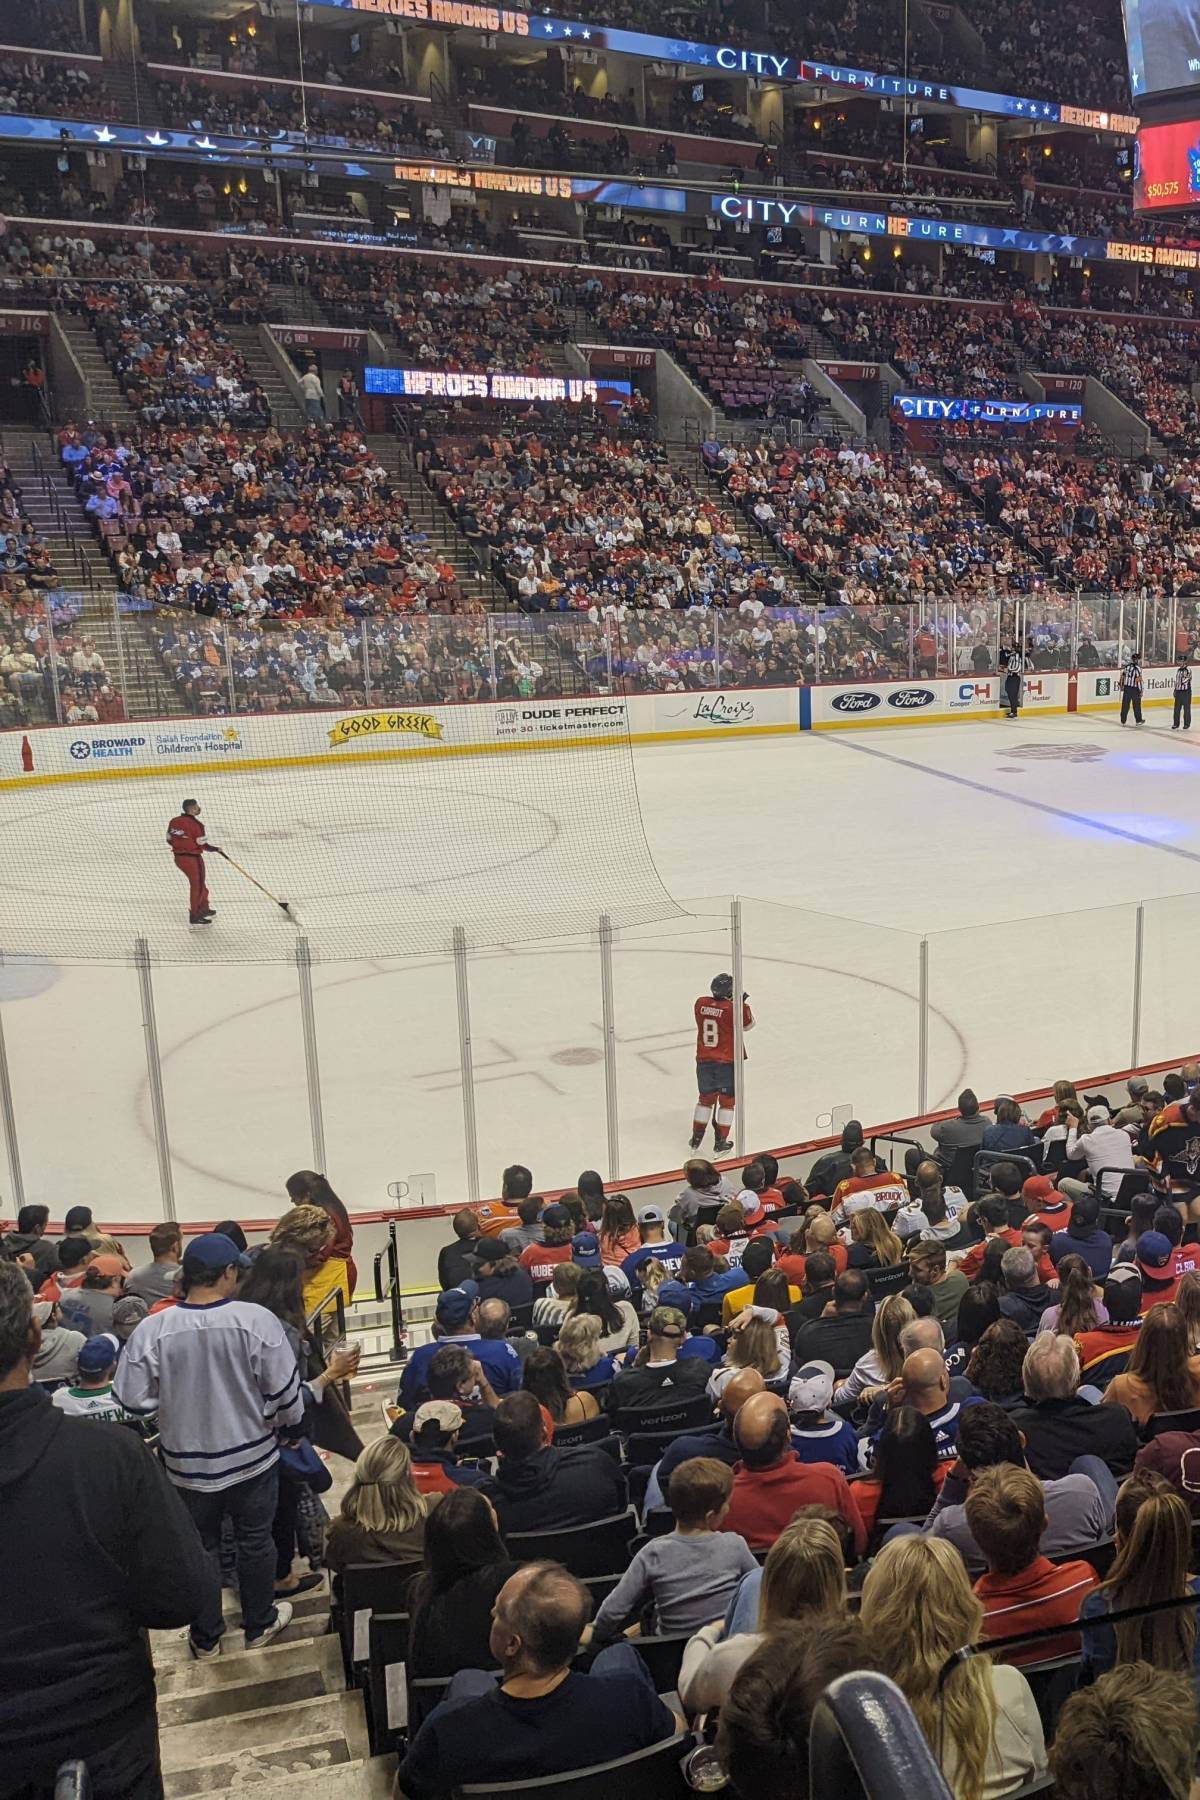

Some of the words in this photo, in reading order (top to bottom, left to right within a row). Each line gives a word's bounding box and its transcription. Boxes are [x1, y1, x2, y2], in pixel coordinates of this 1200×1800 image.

[432, 2, 500, 32] AMONG
[503, 12, 529, 36] US
[716, 47, 788, 77] CITY
[815, 68, 948, 100] FURNITURE
[1060, 105, 1107, 129] HEROE
[545, 176, 572, 198] US
[1147, 181, 1179, 197] $50,575
[720, 197, 797, 224] CITY
[1107, 241, 1153, 263] HEROES
[1154, 248, 1196, 268] AMONG
[20, 317, 42, 331] 116
[635, 353, 651, 366] 118
[862, 367, 876, 379] 119
[404, 371, 488, 397] HEROES
[491, 375, 566, 400] AMONG
[568, 379, 598, 402] US
[1068, 380, 1082, 390] 120
[900, 398, 956, 417] CITY
[974, 406, 1079, 420] FURNITURE
[959, 683, 990, 700] CH
[1147, 678, 1177, 690] Health
[839, 693, 873, 711] Ford
[895, 690, 928, 707] Ford
[522, 709, 561, 720] DUDE
[564, 705, 625, 717] PERFECT
[694, 695, 754, 720] LaCroix
[340, 716, 382, 737] GOOD
[386, 716, 432, 732] GREEK
[496, 727, 517, 735] june
[520, 725, 533, 733] 30
[539, 721, 624, 732] ticketmaster.com
[92, 737, 146, 749] BROWARD
[180, 732, 223, 743] Foundation
[92, 747, 134, 758] HEALTH
[156, 743, 202, 755] Children's
[204, 740, 243, 753] Hospital
[702, 1019, 719, 1048] 8
[874, 1272, 905, 1284] verizon
[639, 1411, 688, 1425] verizon
